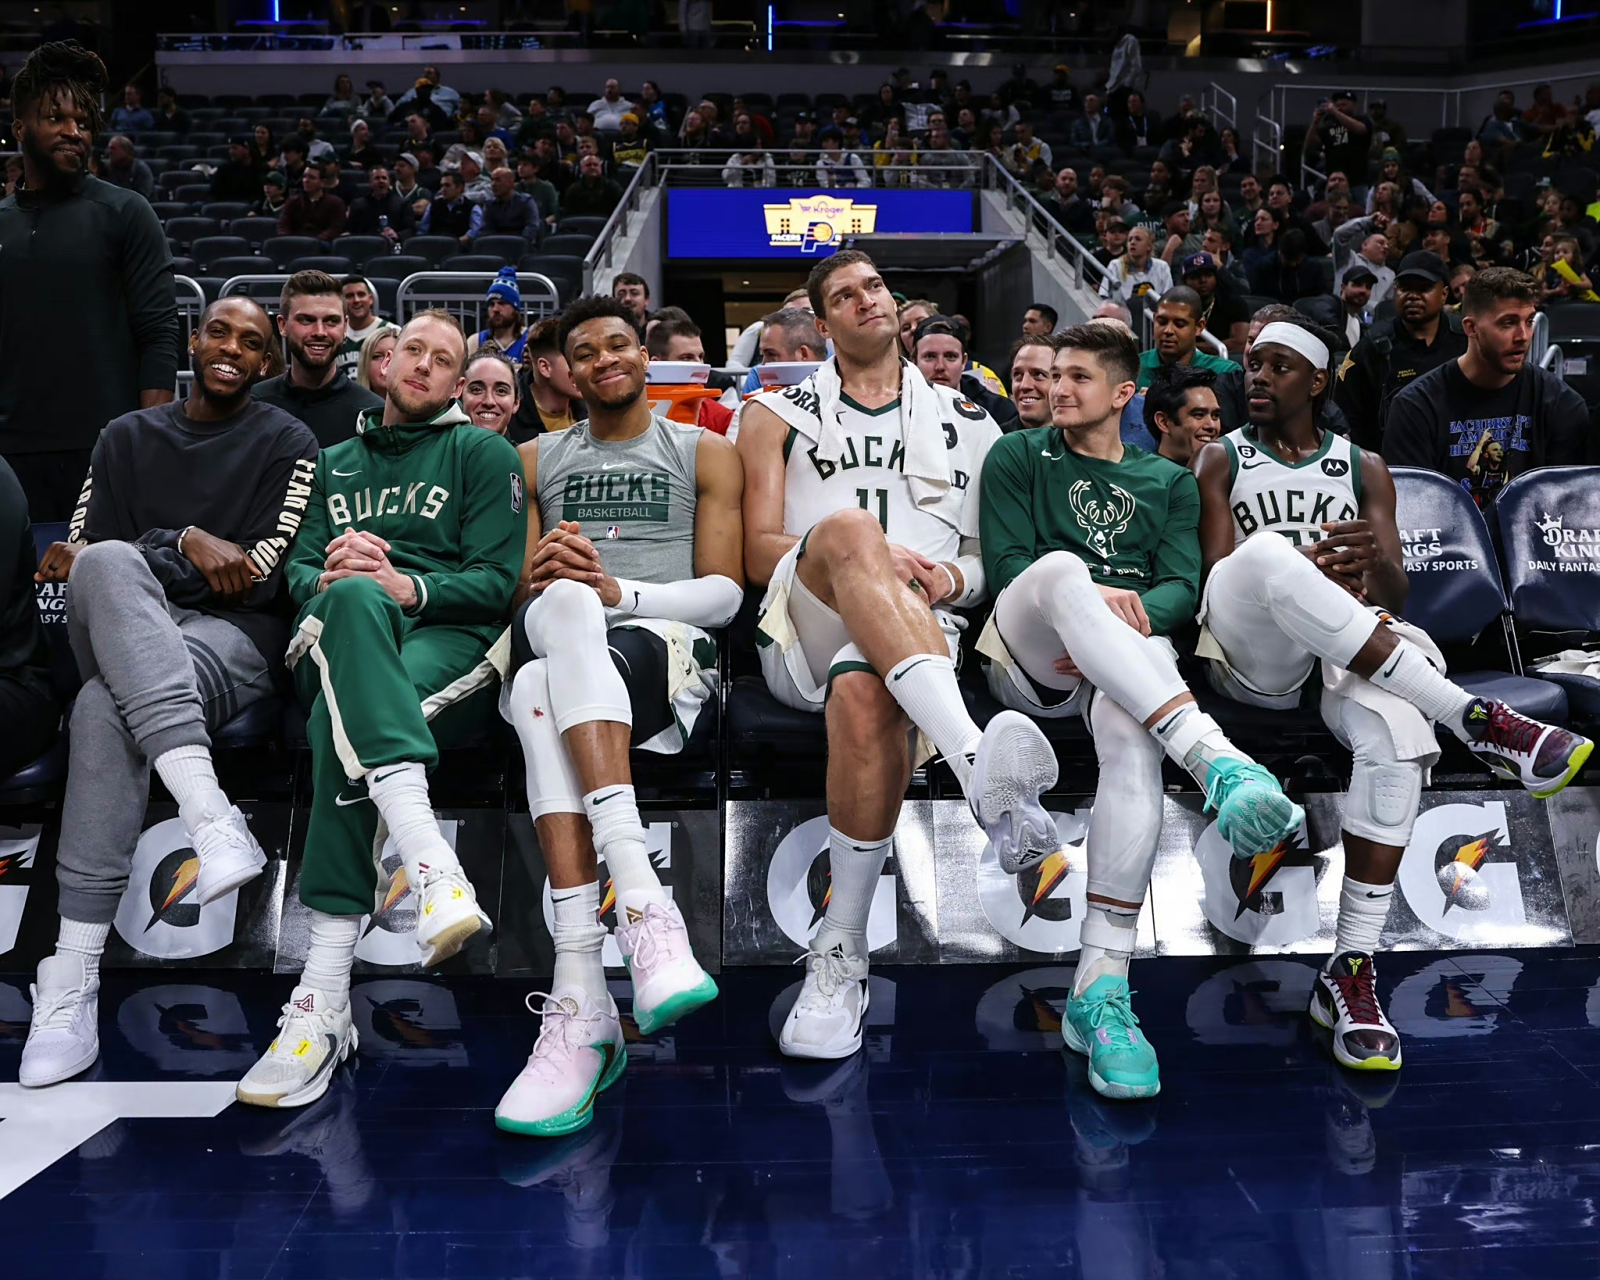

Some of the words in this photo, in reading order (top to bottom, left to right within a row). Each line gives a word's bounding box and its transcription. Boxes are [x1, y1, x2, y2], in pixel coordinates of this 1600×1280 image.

[813, 201, 844, 219] Kroger
[806, 435, 905, 481] BUCK
[283, 458, 317, 512] FEAR
[563, 472, 670, 504] BUCKS
[326, 481, 450, 526] BUCKS
[577, 507, 652, 518] BASKETBALL
[1399, 528, 1442, 542] AFT
[1543, 527, 1600, 546] DRAF
[1401, 542, 1443, 558] NGS
[1432, 559, 1479, 571] SPORTS
[1528, 560, 1556, 571] DAILY
[1559, 562, 1600, 572] FANTAS
[1398, 800, 1527, 942] G
